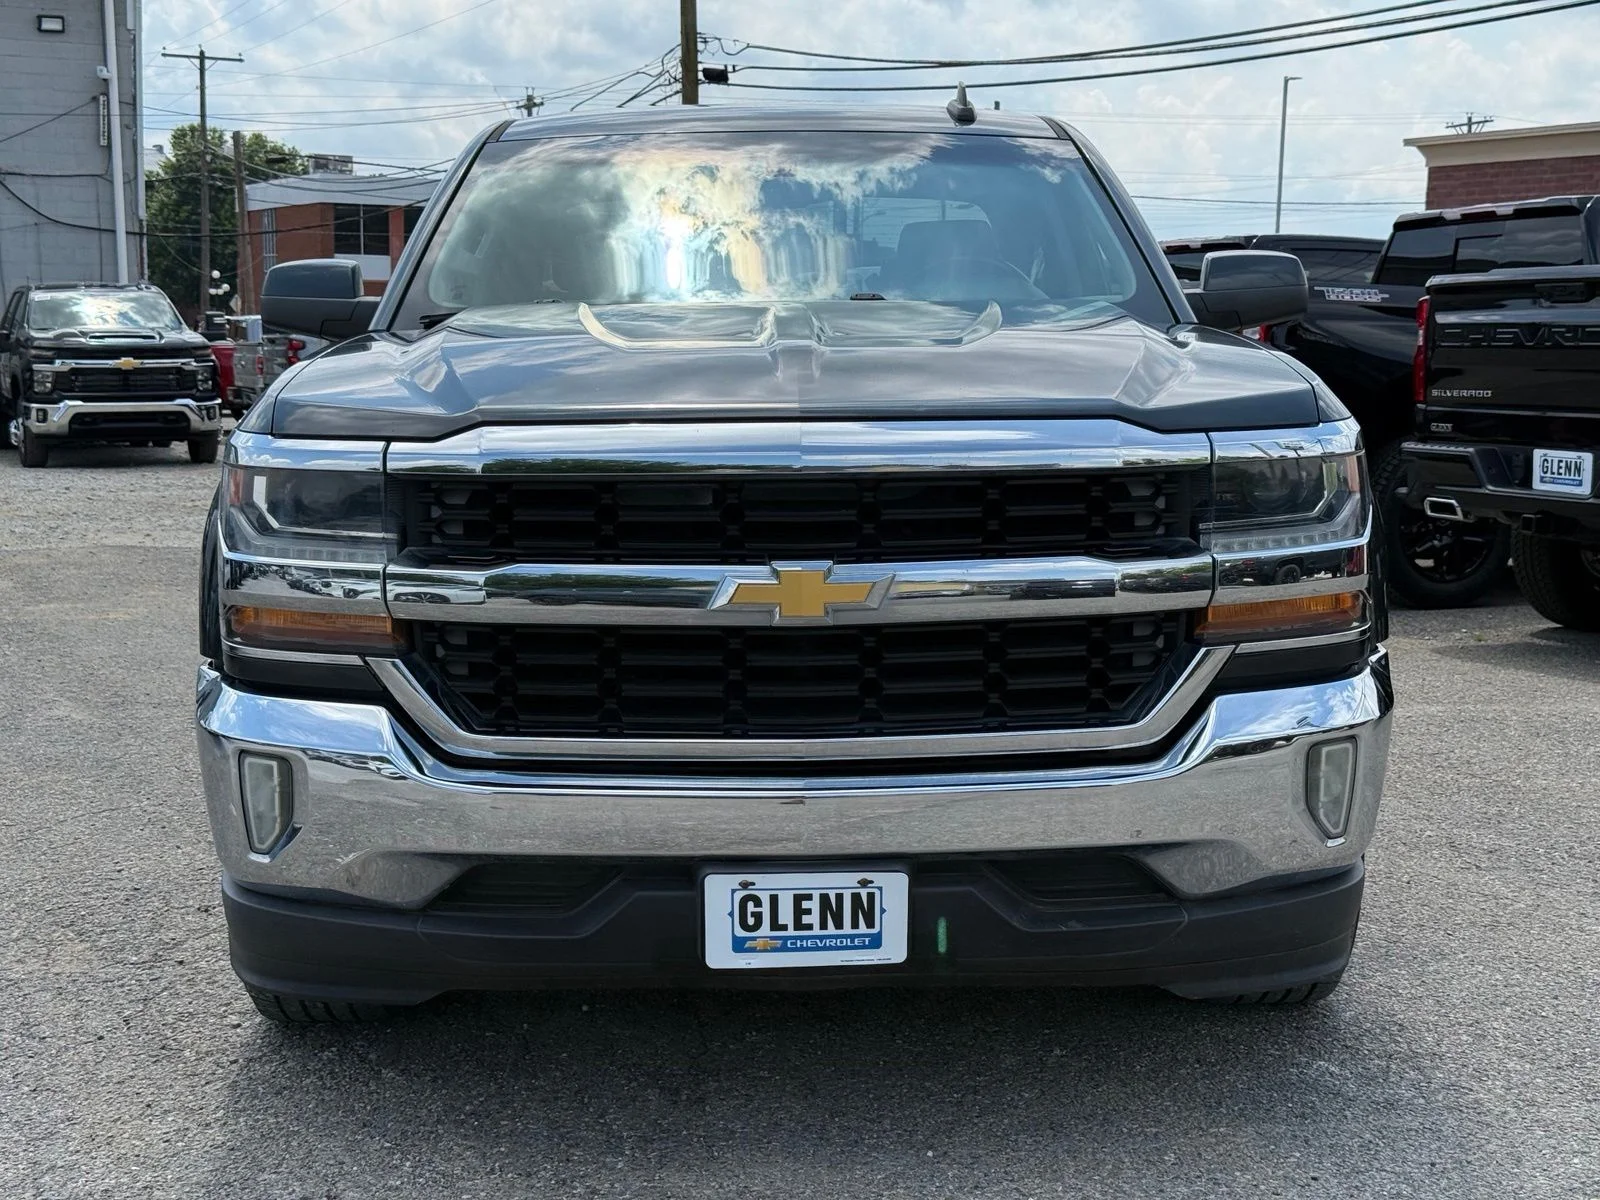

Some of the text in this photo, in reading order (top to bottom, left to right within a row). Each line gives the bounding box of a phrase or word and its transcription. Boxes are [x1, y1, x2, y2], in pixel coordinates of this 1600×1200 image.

[1431, 389, 1492, 397] SILVERADO
[1541, 458, 1582, 477] GLENN
[738, 891, 876, 933] GLENN
[787, 937, 872, 948] CHEVROLET
